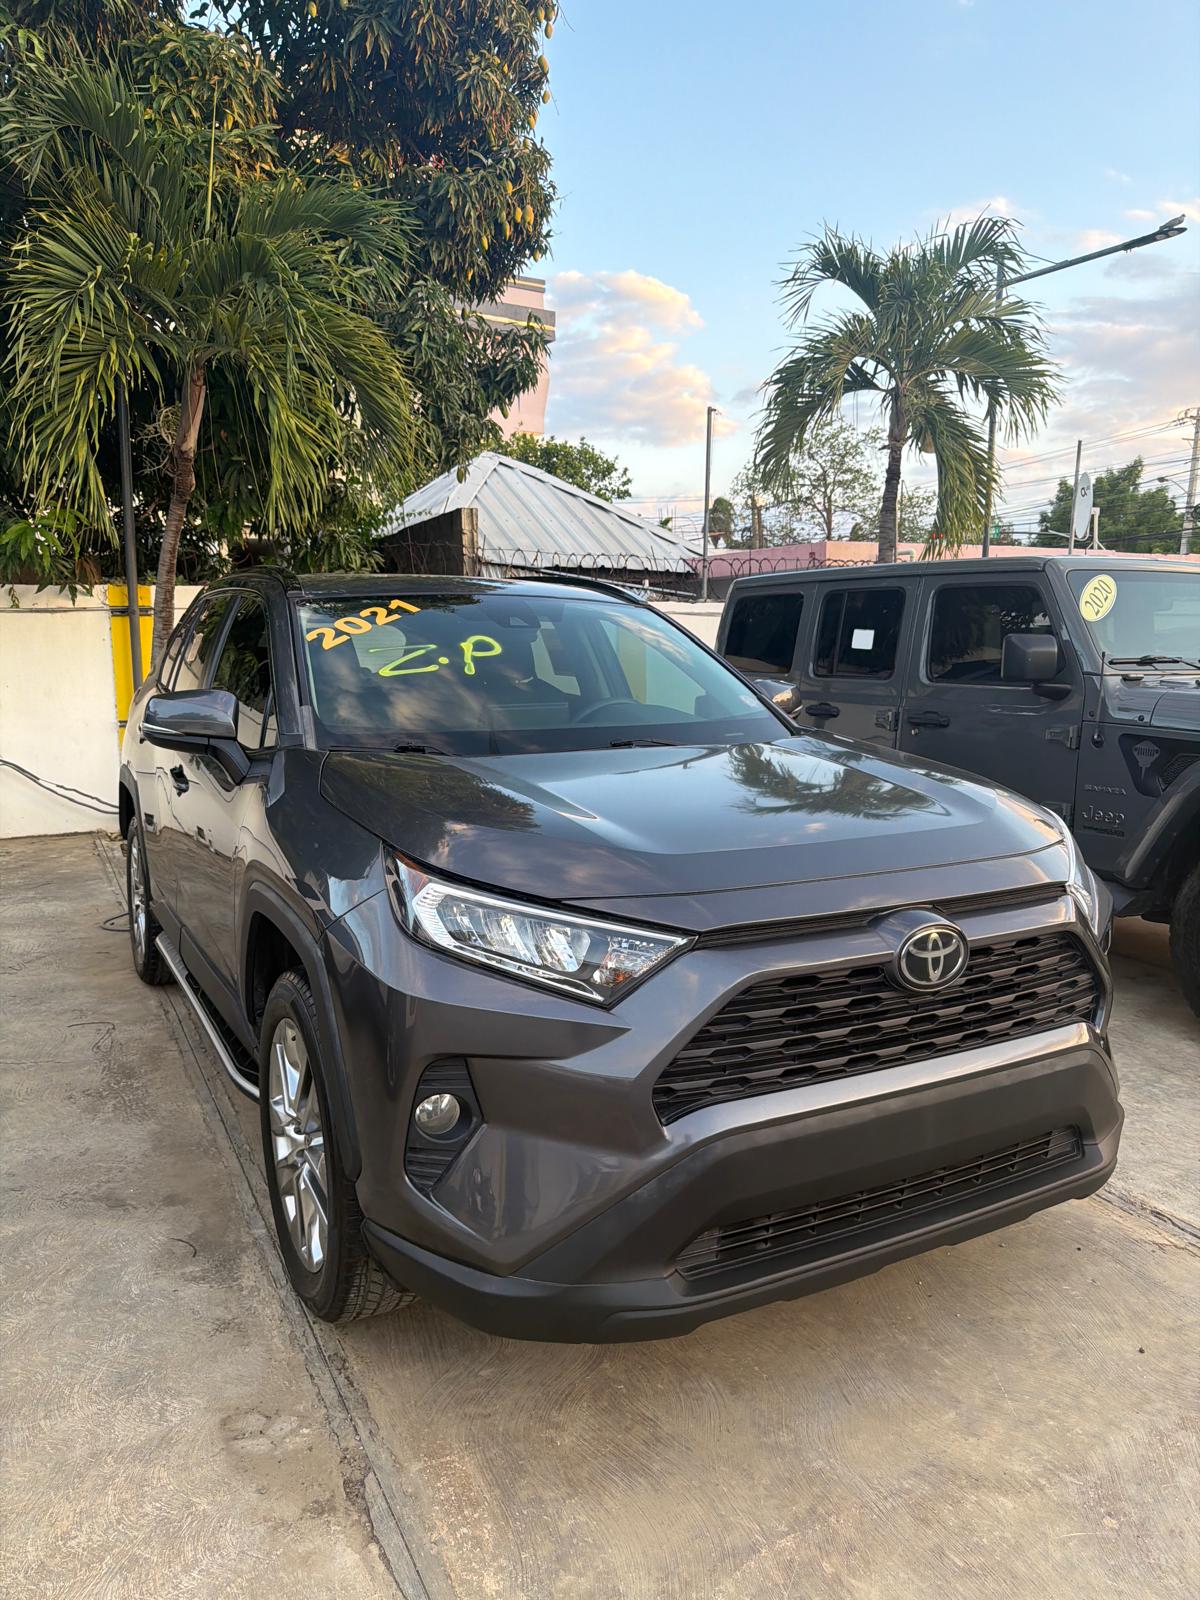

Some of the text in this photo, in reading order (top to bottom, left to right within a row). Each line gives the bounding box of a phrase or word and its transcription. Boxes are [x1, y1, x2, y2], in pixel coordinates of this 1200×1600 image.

[1084, 579, 1113, 617] 2020
[305, 598, 422, 651] 2021
[1081, 804, 1125, 828] Jeep
